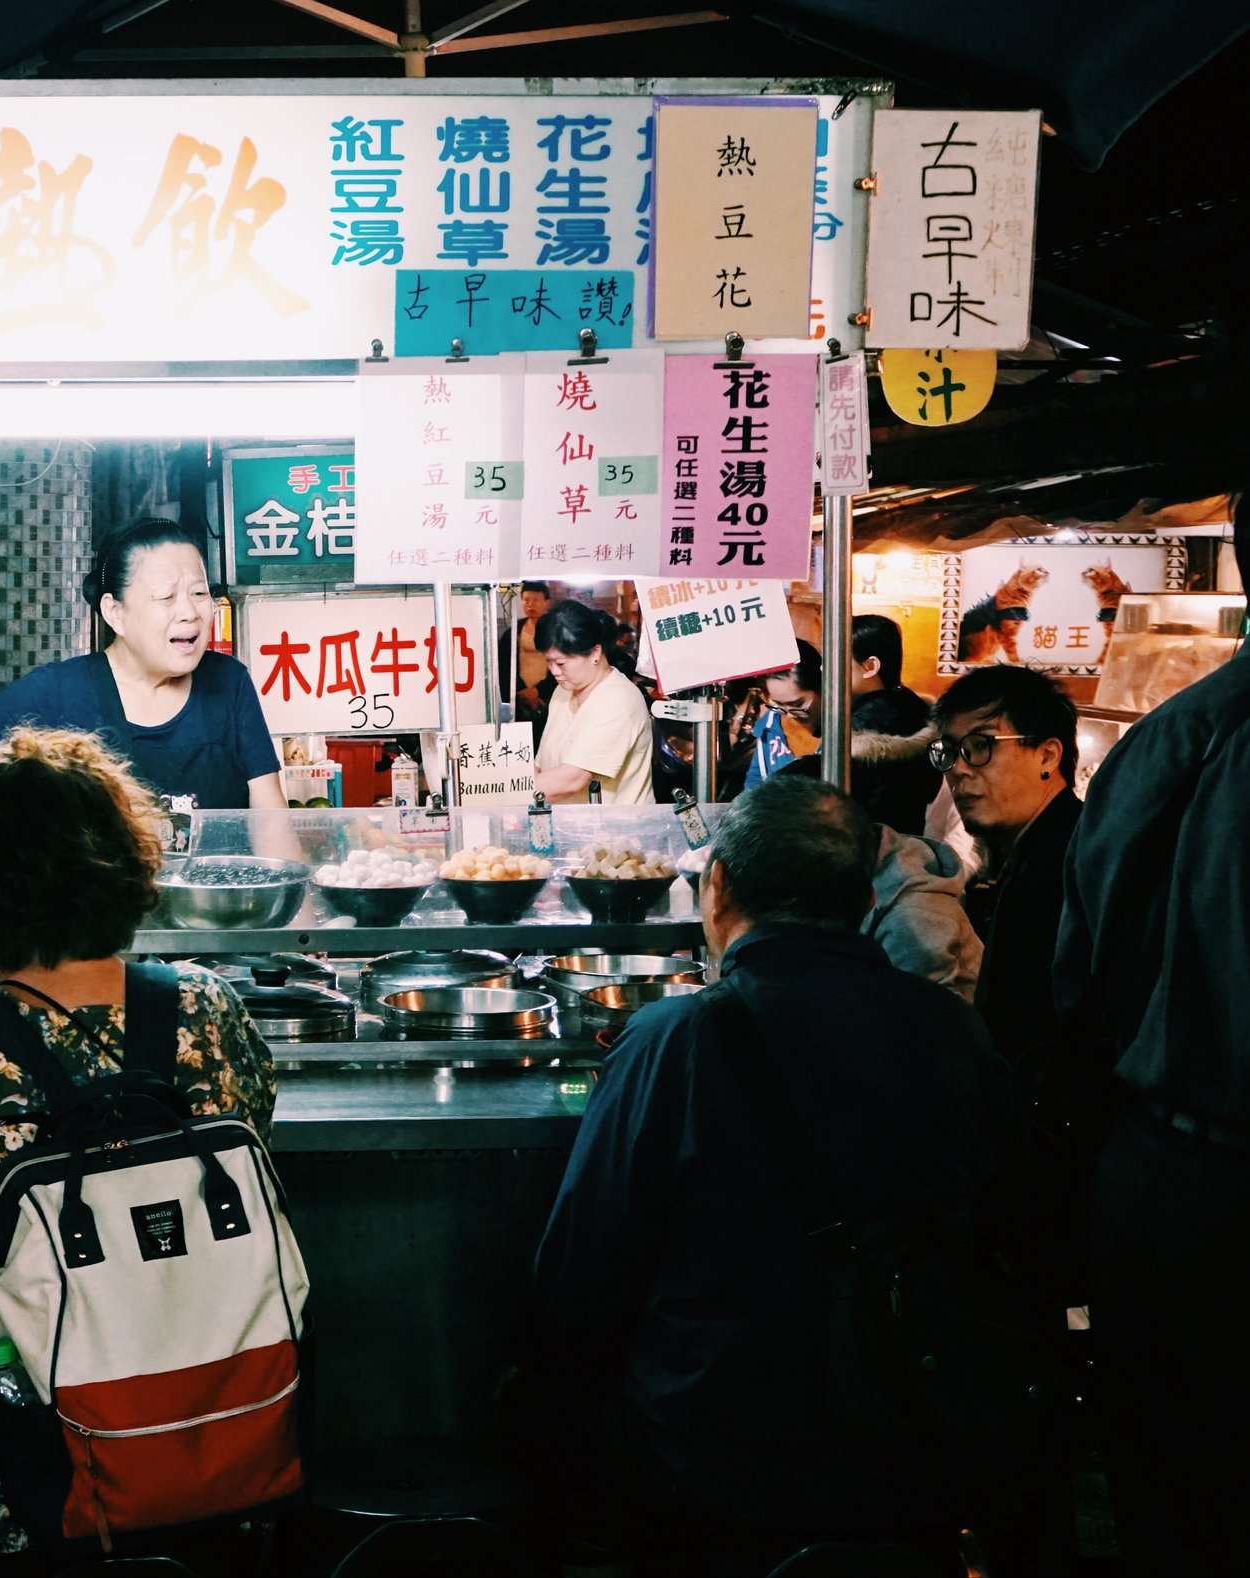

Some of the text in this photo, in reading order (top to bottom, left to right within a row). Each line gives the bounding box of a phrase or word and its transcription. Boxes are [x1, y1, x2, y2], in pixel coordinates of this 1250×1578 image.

[330, 115, 404, 266] 紅豆湯
[436, 115, 511, 266] 燒仙草
[536, 115, 612, 266] 花生湯
[714, 134, 757, 310] 熱豆花
[910, 121, 997, 337] 古早味
[404, 274, 632, 328] 古早味讚!
[556, 371, 598, 524] 燒仙草
[828, 363, 858, 482] 請先付款
[473, 466, 506, 491] 35
[604, 464, 634, 484] 35
[669, 435, 699, 566] 可任選二種料
[717, 370, 771, 566] 花生湯40元
[474, 505, 498, 526] 元
[615, 500, 638, 520] 元
[527, 543, 635, 563] 任選二種料
[260, 626, 475, 702] 木瓜牛奶
[1033, 625, 1091, 649] 貓王
[348, 693, 396, 729] 35
[459, 740, 531, 768] 香蕉牛奶
[510, 775, 534, 793] Milk
